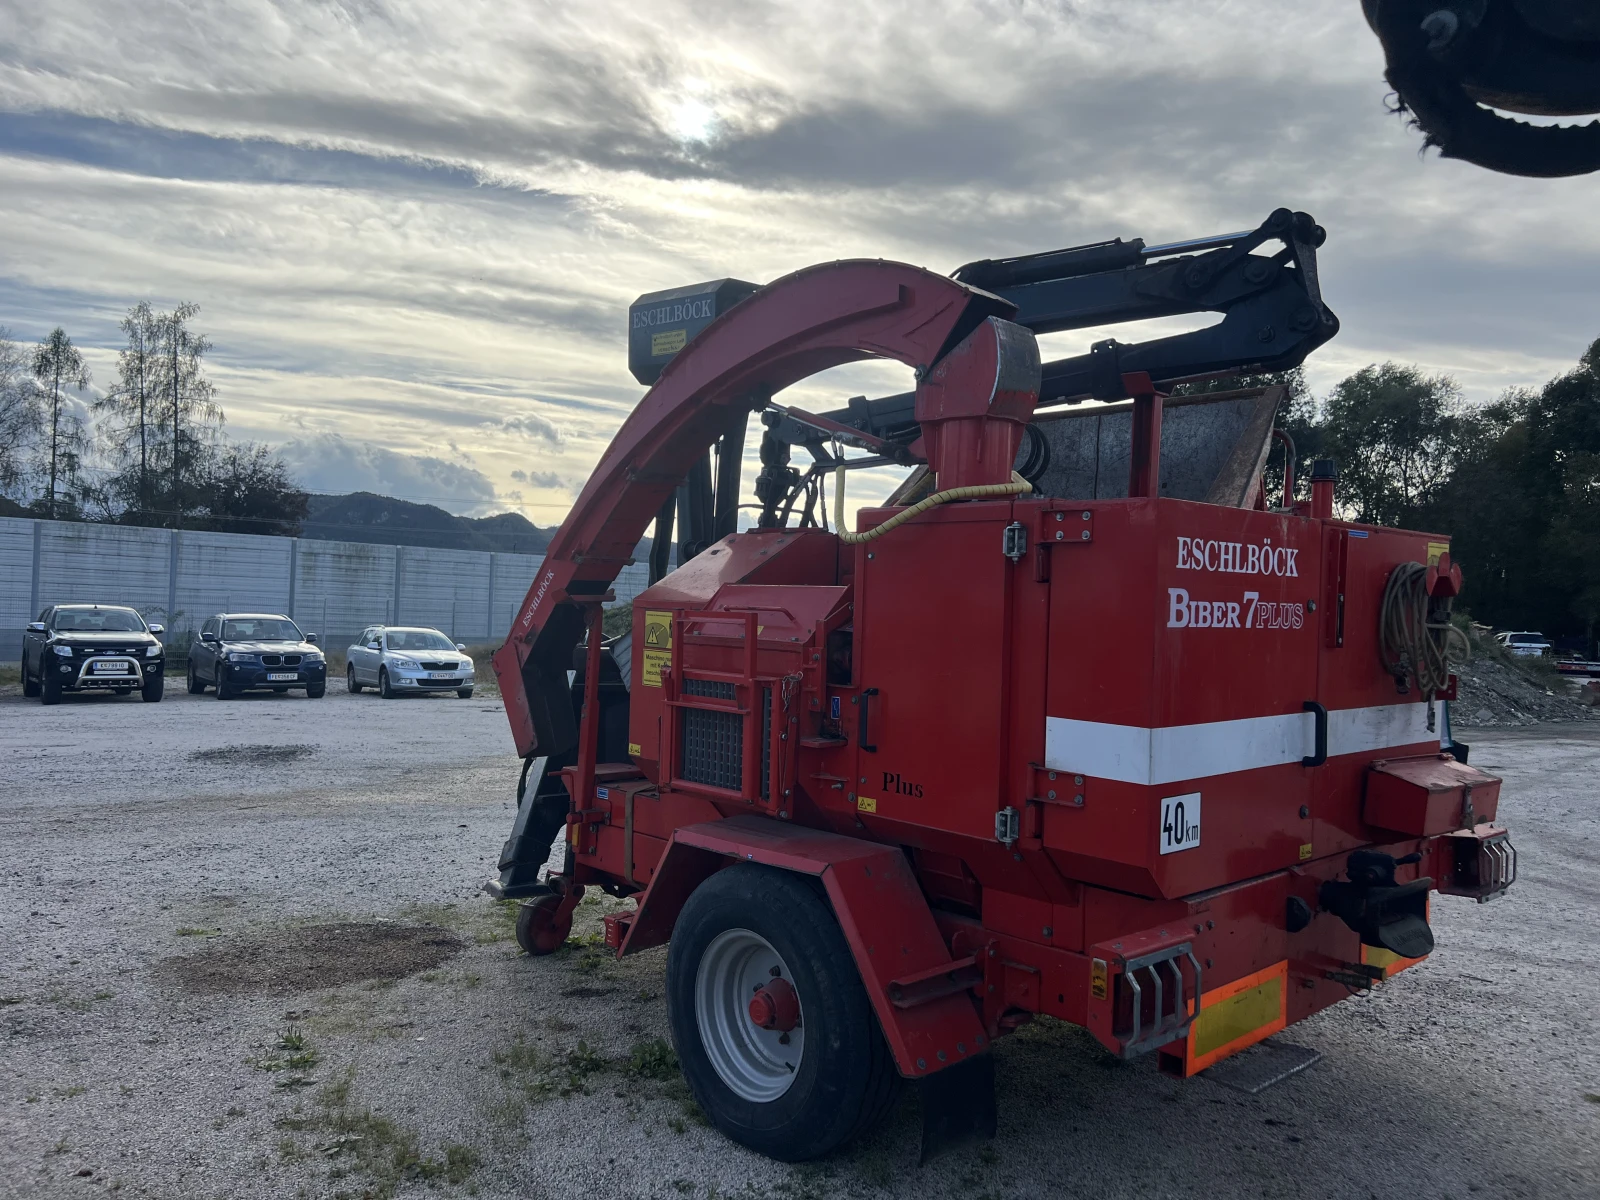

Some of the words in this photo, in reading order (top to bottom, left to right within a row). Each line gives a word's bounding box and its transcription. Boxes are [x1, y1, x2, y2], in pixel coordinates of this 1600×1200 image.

[633, 298, 711, 328] ESCHLBÖCK
[1176, 536, 1299, 578] ESCHLBÖCK
[522, 569, 555, 627] ESCHLBÖCK
[882, 771, 924, 798] Plus
